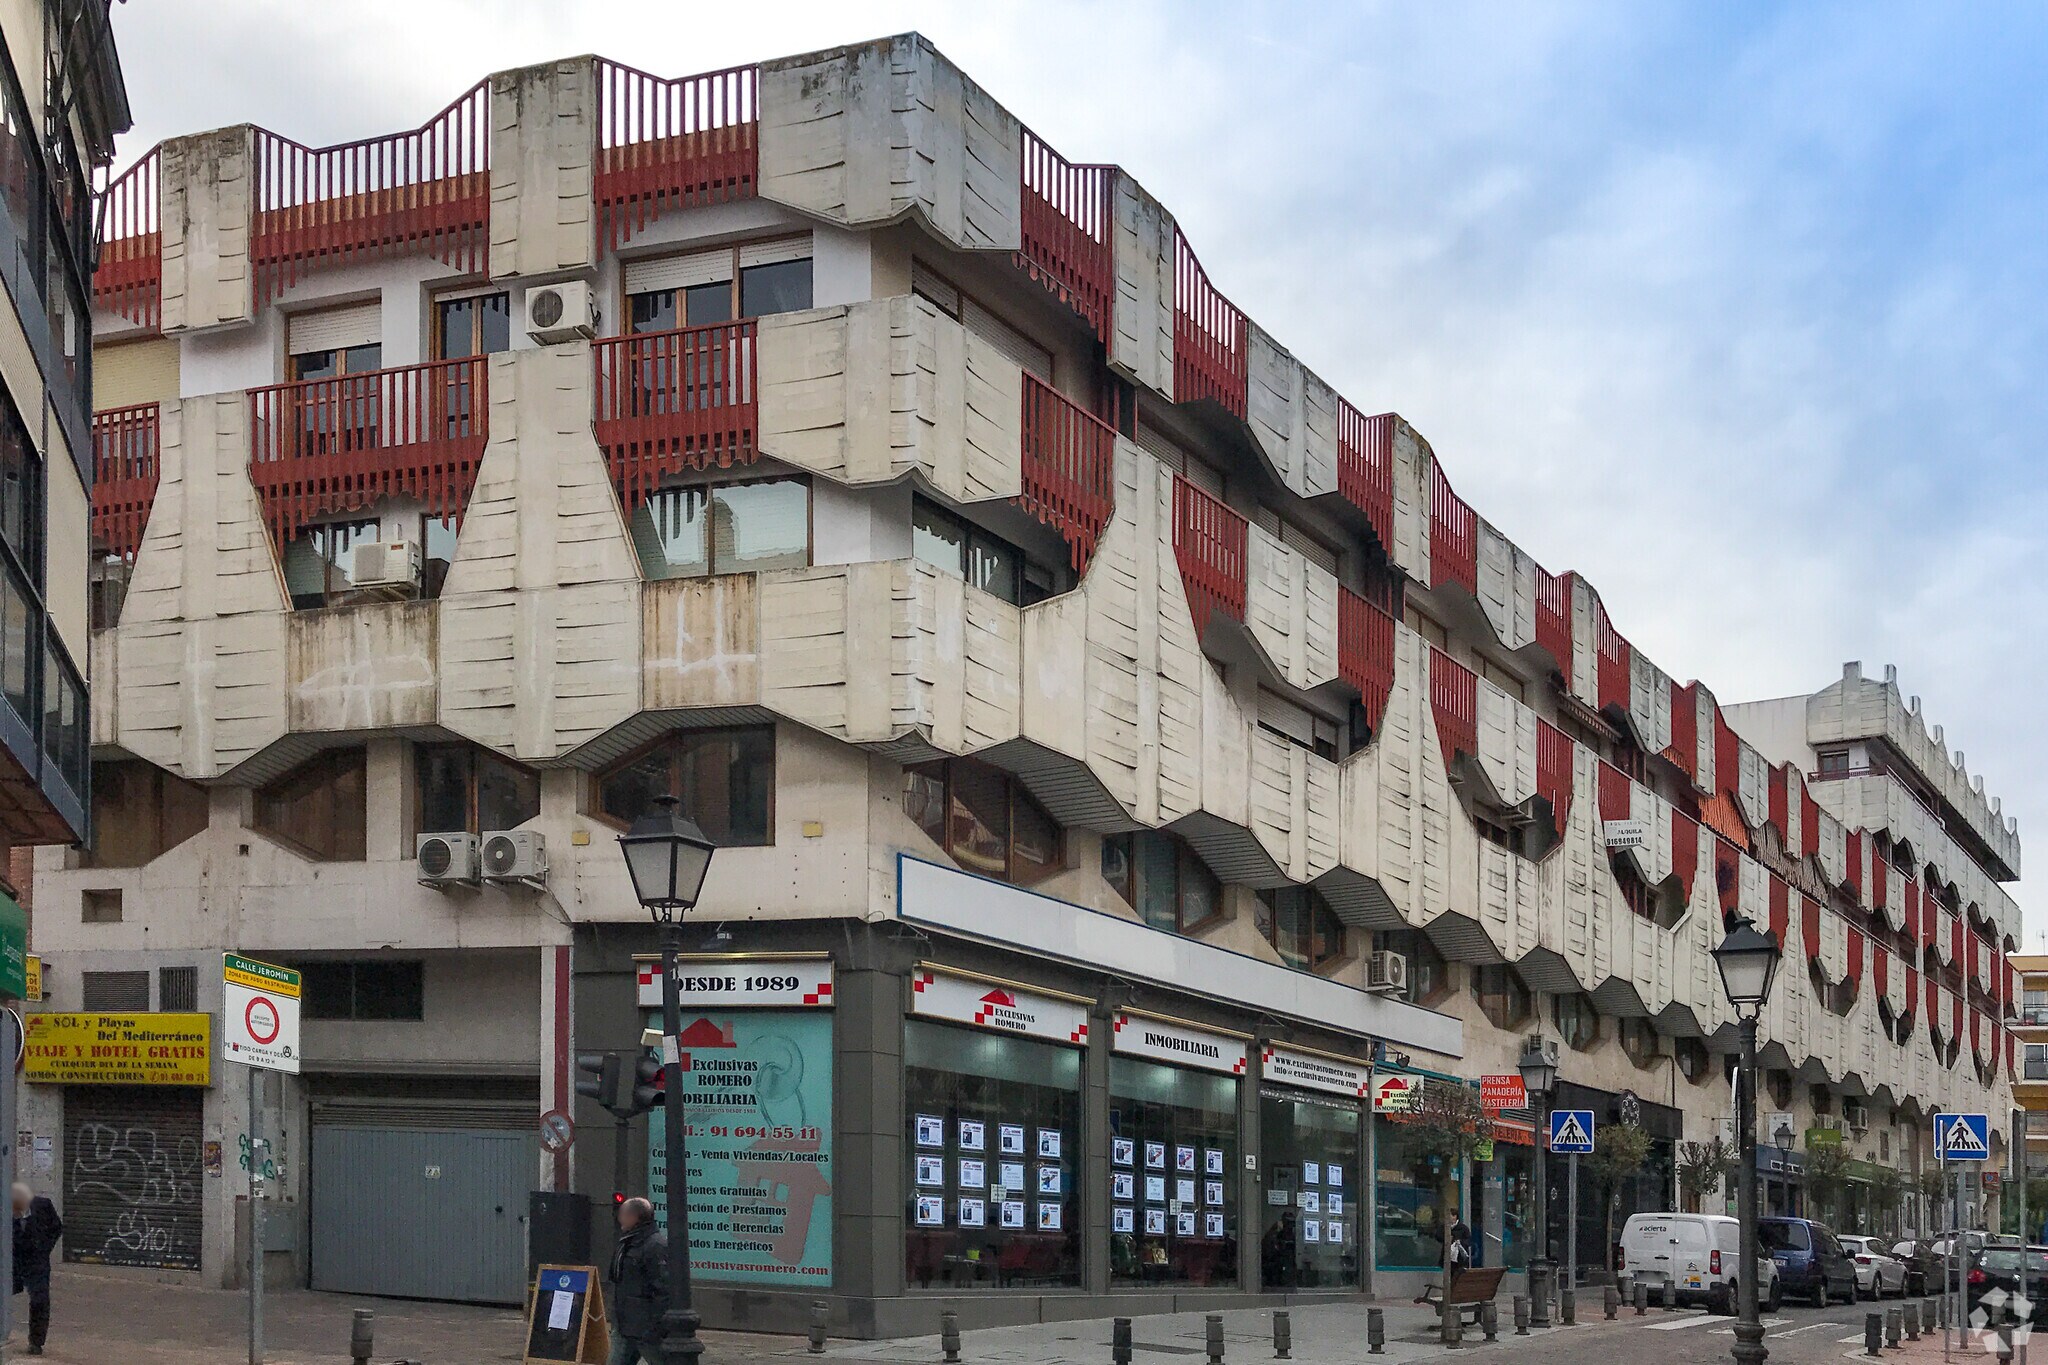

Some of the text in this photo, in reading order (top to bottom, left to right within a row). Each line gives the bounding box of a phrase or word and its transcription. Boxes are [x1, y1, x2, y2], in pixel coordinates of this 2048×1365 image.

[236, 960, 289, 981] CALLE JEROMÍN
[744, 976, 799, 991] 1989
[995, 1008, 1035, 1023] EXCLUSIVAS
[54, 1016, 135, 1029] SOL y Playas
[995, 1018, 1026, 1030] ROMERO
[97, 1030, 204, 1041] Del Mediterráneo
[25, 1045, 205, 1058] VIAJE Y HOTEL GRATIS
[225, 1042, 251, 1052] PETIDO
[1144, 1032, 1219, 1058] INMOBILIARIA
[50, 1060, 96, 1068] CUALQUIER
[692, 1059, 758, 1071] Exclusivas
[1275, 1056, 1357, 1079] www.exclusivasromero.com
[25, 1071, 57, 1079] SOMOS
[61, 1071, 145, 1080] CONSTRUCTORES
[698, 1074, 752, 1087] ROMERO
[1482, 1076, 1510, 1085] PRENSA
[1482, 1086, 1522, 1096] PANADERÍA
[683, 1093, 758, 1105] OBILIARIA
[710, 1125, 728, 1137] 91
[734, 1126, 766, 1138] 694
[772, 1127, 794, 1139] 55
[800, 1127, 816, 1140] 11
[652, 1149, 690, 1159] Coa
[701, 1150, 730, 1160] Venta
[733, 1151, 829, 1163] Viviendas/Locales
[652, 1184, 767, 1198] Valciones Gratuitas
[652, 1202, 713, 1213] Traación
[717, 1203, 730, 1213] de
[717, 1221, 730, 1231] de
[732, 1222, 784, 1234] Herencias
[1643, 1224, 1667, 1232] acierta
[713, 1239, 773, 1251] Energéticos
[689, 1261, 829, 1275] exclusivasromero.com
